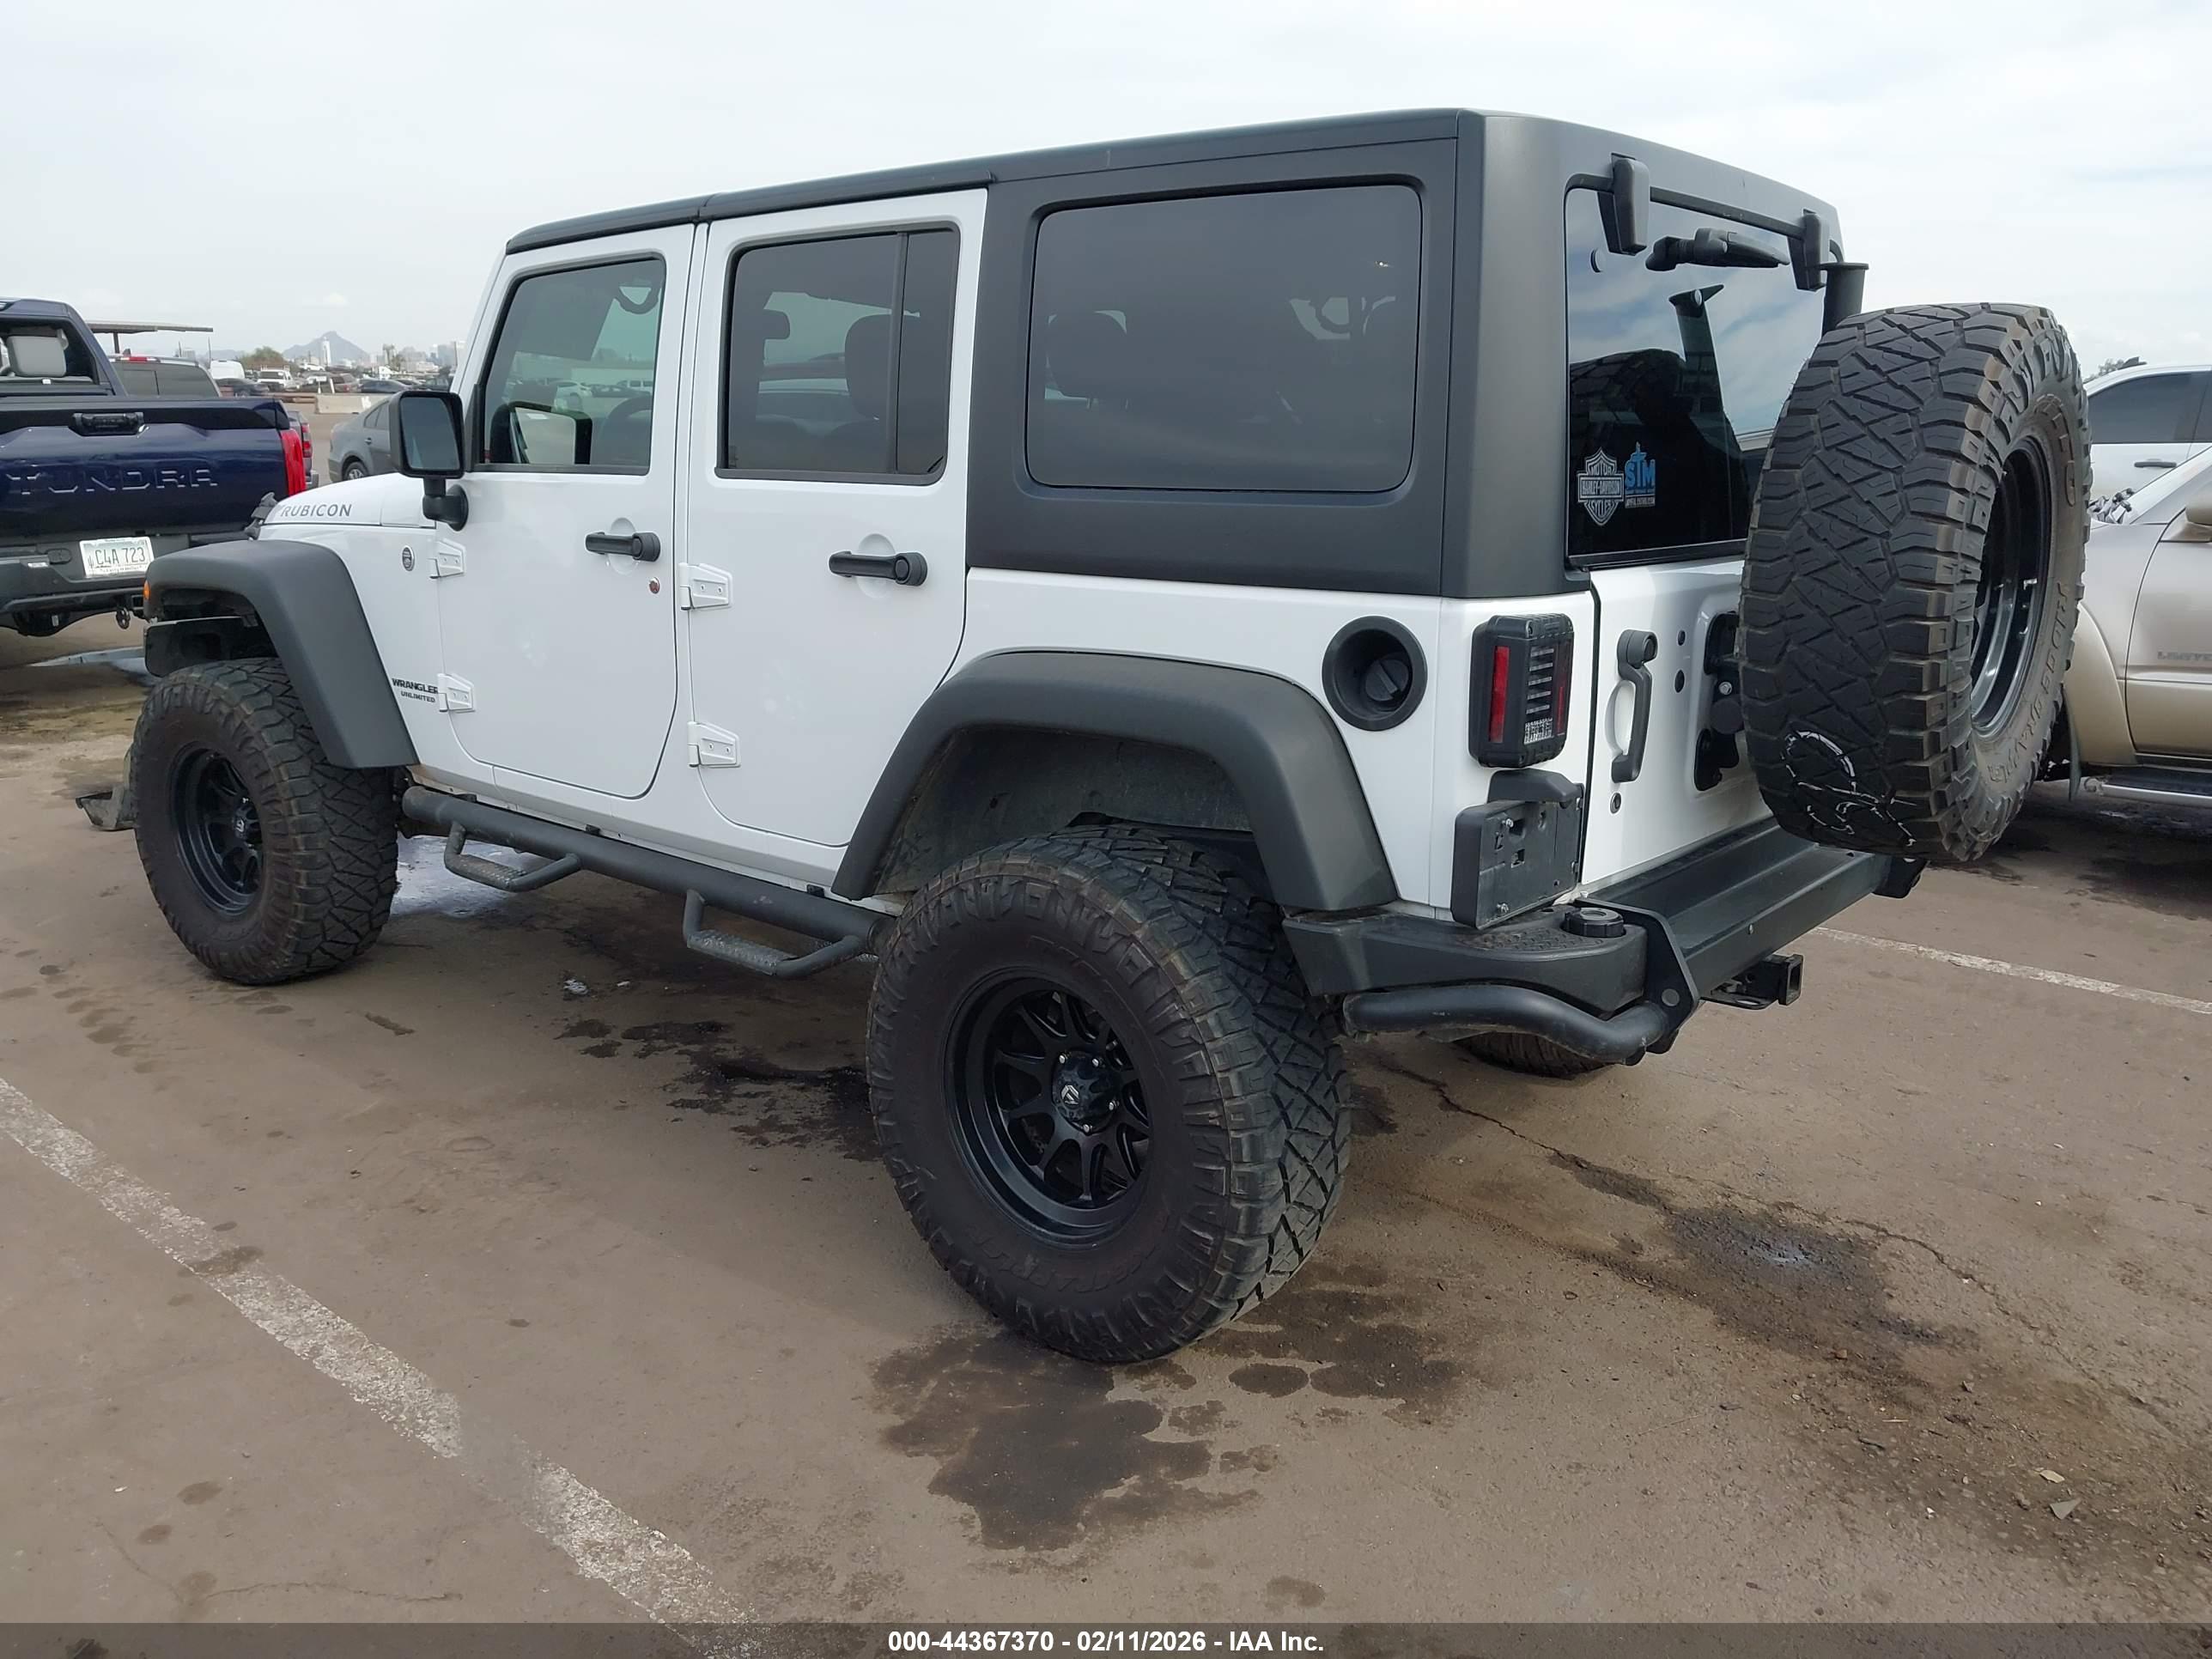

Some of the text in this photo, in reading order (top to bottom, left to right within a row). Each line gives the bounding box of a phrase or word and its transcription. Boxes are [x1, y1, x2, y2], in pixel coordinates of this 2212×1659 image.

[5, 468, 218, 495] TUNDRA
[1583, 480, 1620, 495] HARLEY-DAVIDSON
[280, 504, 352, 517] RUBICON
[121, 547, 146, 563] 723
[391, 678, 439, 695] WRANGLER
[400, 690, 436, 703] UNLIMITED
